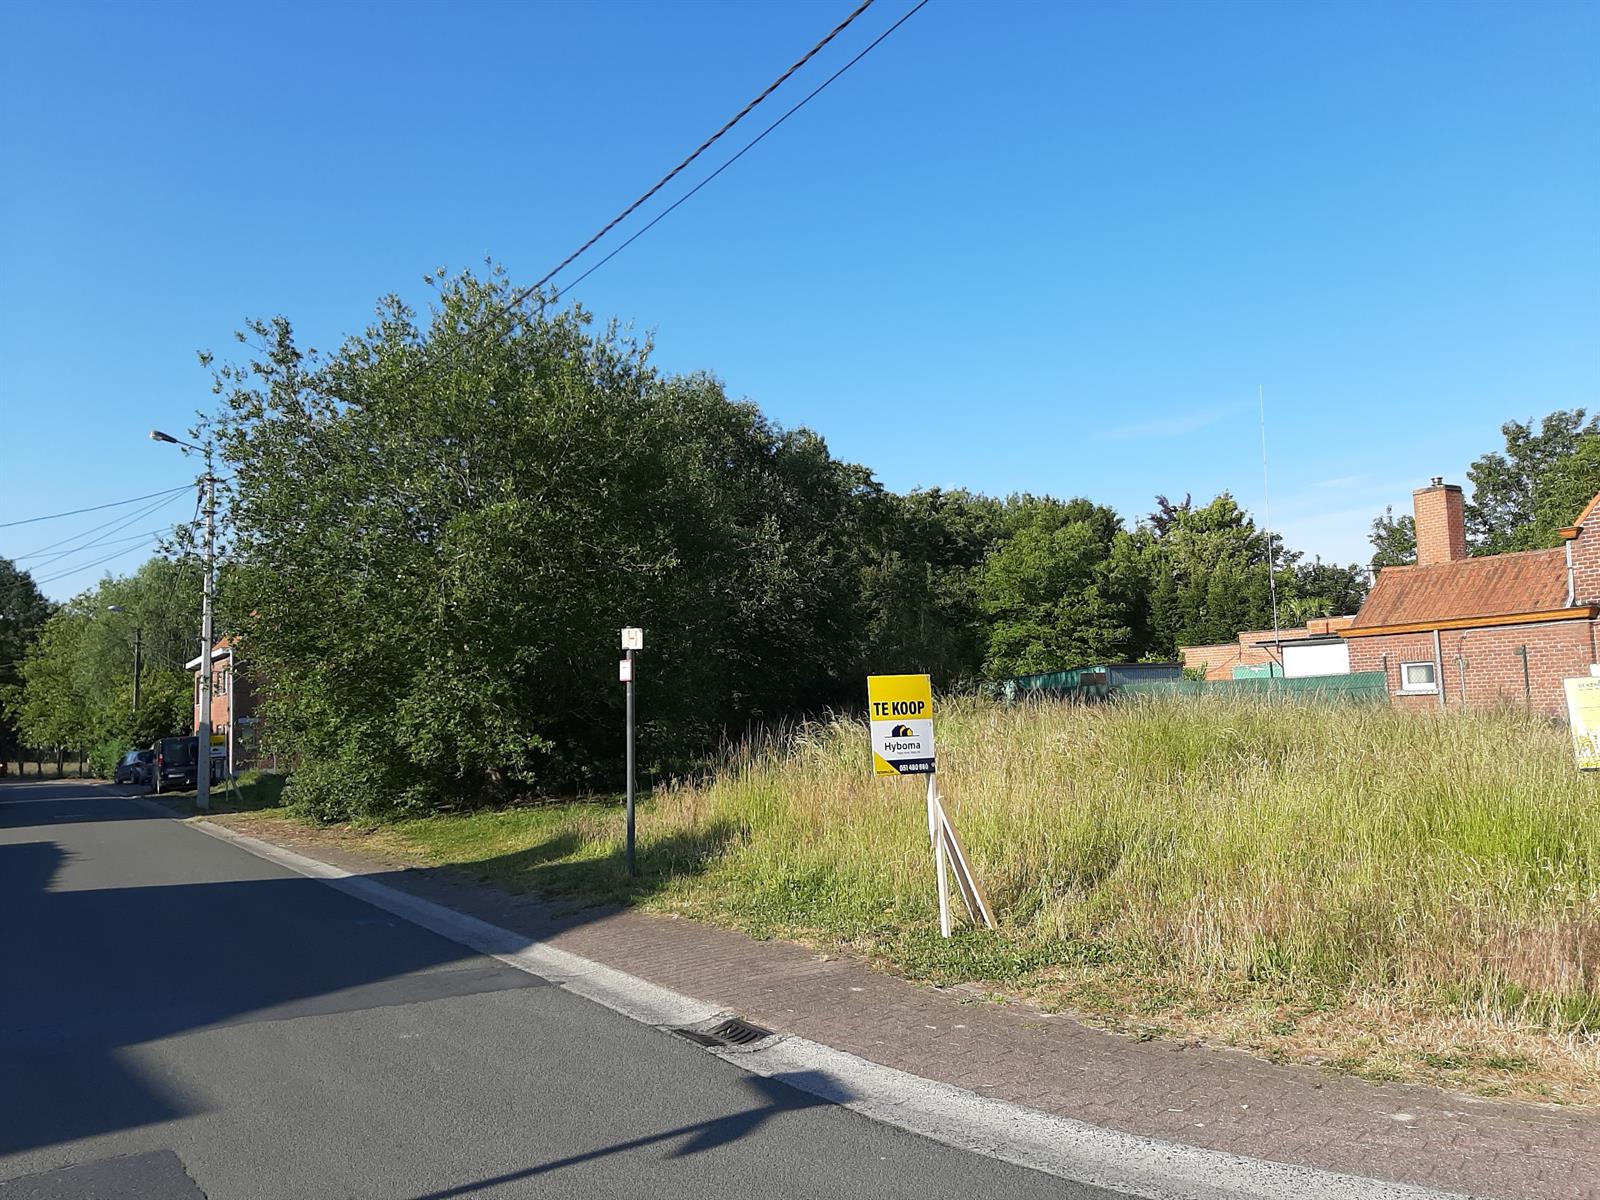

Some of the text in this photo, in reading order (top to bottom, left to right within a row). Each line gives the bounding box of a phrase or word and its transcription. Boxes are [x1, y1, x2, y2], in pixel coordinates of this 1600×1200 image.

[873, 701, 925, 716] TE KOOP
[884, 742, 921, 752] Hyboma
